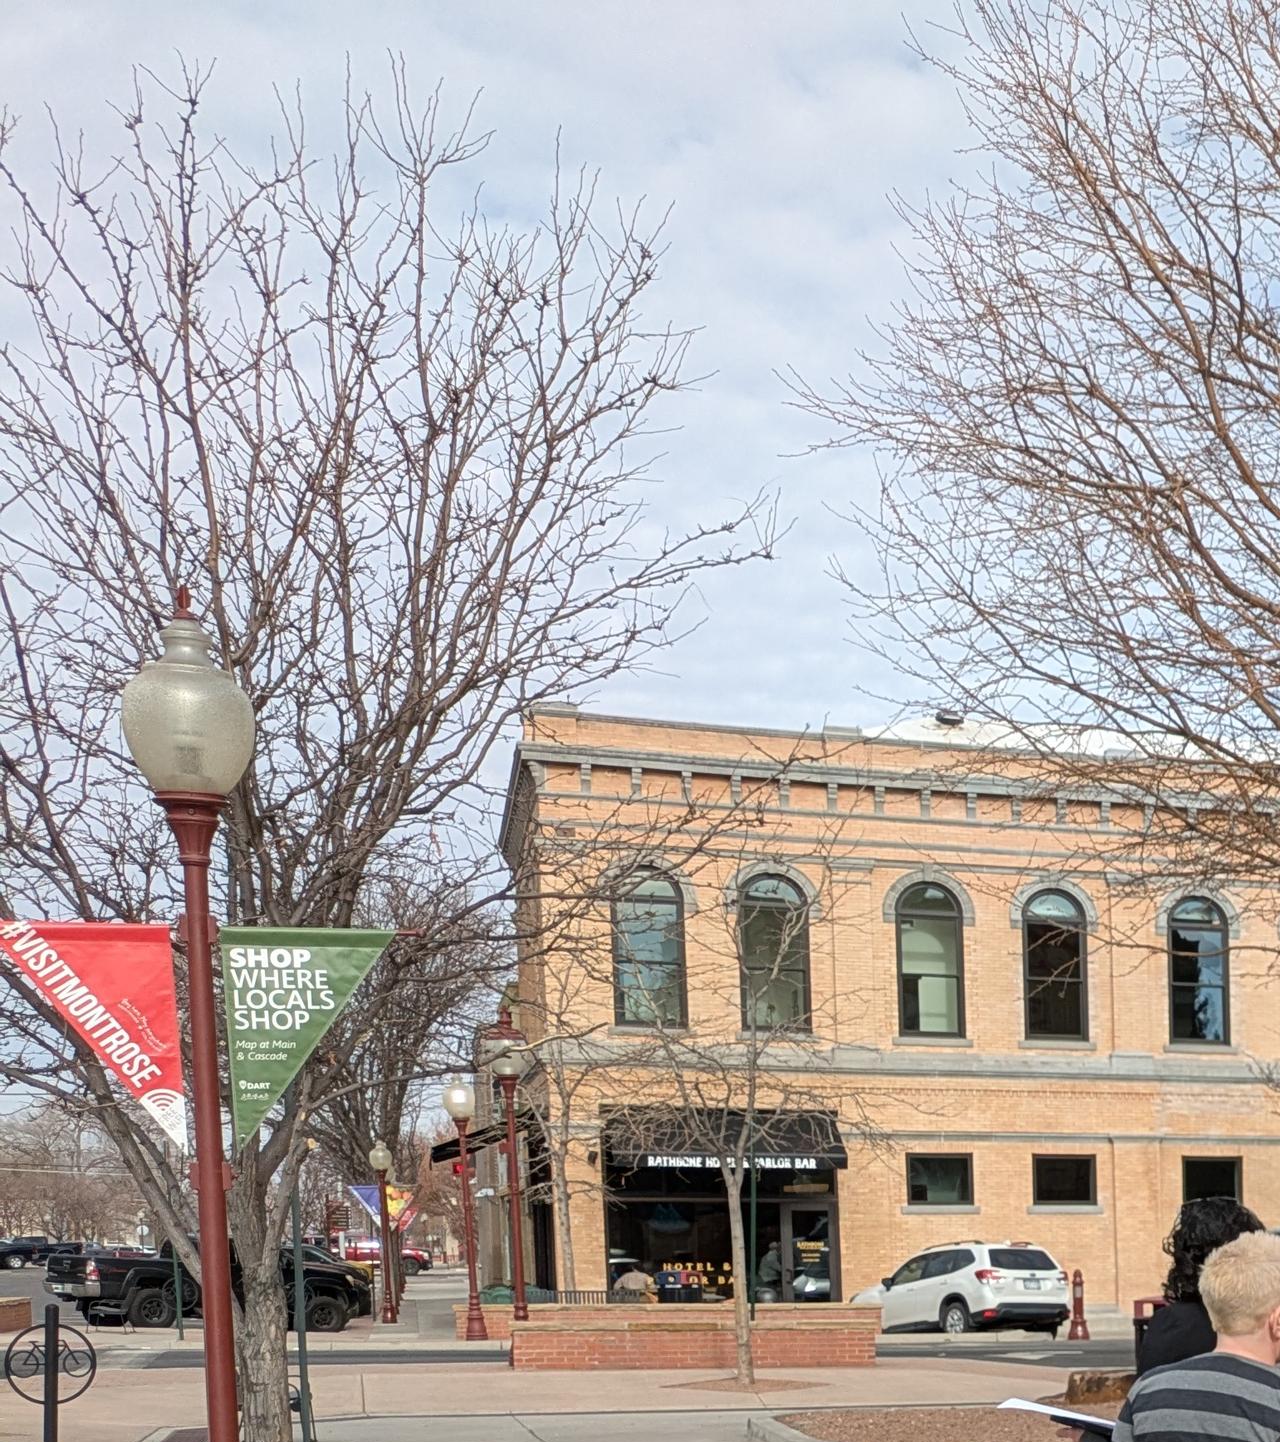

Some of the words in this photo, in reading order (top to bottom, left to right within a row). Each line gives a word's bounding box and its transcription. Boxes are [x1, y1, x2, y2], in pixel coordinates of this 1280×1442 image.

[229, 948, 311, 968] SHOP
[230, 968, 329, 989] WHERE
[0, 920, 163, 1089] #VISITMONTROSE
[233, 989, 335, 1010] LOCALS
[234, 1010, 310, 1030] SHOP
[235, 1040, 257, 1052] Map
[259, 1041, 270, 1049] at
[272, 1040, 296, 1049] Main
[236, 1051, 245, 1061] &
[248, 1051, 288, 1061] Cascade
[247, 1082, 271, 1090] DART
[794, 1158, 817, 1169] BAR
[663, 1262, 715, 1271] HOTEL
